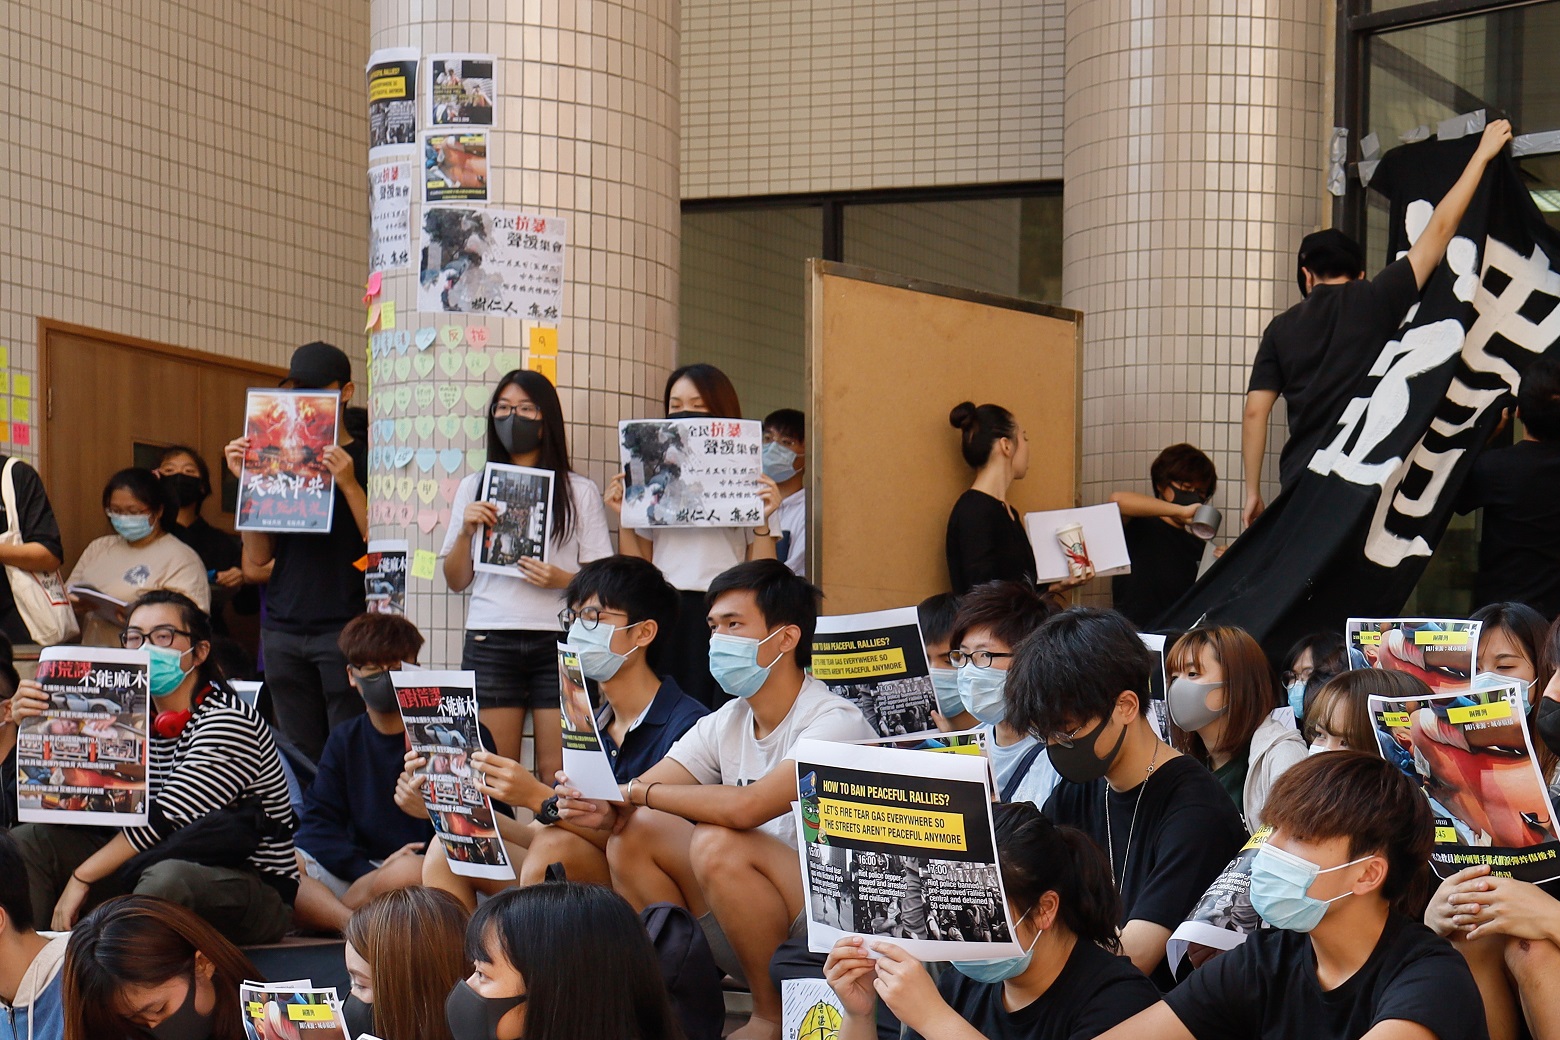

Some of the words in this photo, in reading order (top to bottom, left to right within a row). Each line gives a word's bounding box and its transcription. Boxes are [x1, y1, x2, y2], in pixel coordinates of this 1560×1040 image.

[493, 215, 546, 234] 全民抗暴
[688, 422, 741, 437] 全民抗暴
[248, 473, 324, 499] 天滅中共
[831, 641, 856, 650] PEACEFUL
[857, 637, 890, 649] RALLIES?
[843, 655, 878, 665] EVERYWHERE
[845, 666, 871, 674] PEACEFUL
[872, 662, 902, 672] ANYMORE
[78, 669, 148, 689] 不能麻木
[436, 696, 478, 718] 不能麻木
[823, 780, 838, 793] HOW
[840, 782, 849, 795] TO
[851, 784, 865, 797] BAN
[867, 786, 907, 802] PEACEFUL
[909, 791, 950, 806] RALLIES?
[823, 805, 839, 816] LET'S
[840, 807, 852, 818] FIRE
[854, 809, 869, 820] TEAR
[871, 811, 885, 822] GAS
[887, 813, 932, 828] EVERYWHERE
[935, 818, 945, 828] SO
[824, 819, 834, 830] THE
[835, 821, 861, 833] STREETS
[862, 824, 887, 837] AREN'T
[888, 828, 922, 841] PEACEFUL
[924, 832, 962, 845] ANYMORE
[858, 855, 876, 866] 16:00
[926, 864, 947, 875] 17:00
[928, 879, 939, 887] Riot
[940, 880, 957, 889] police
[928, 887, 966, 896] pre-approved
[967, 889, 985, 898] rallies
[987, 890, 992, 898] in
[929, 895, 948, 903] central
[950, 896, 960, 904] and
[961, 897, 988, 905] detained
[939, 903, 963, 911] civilians
